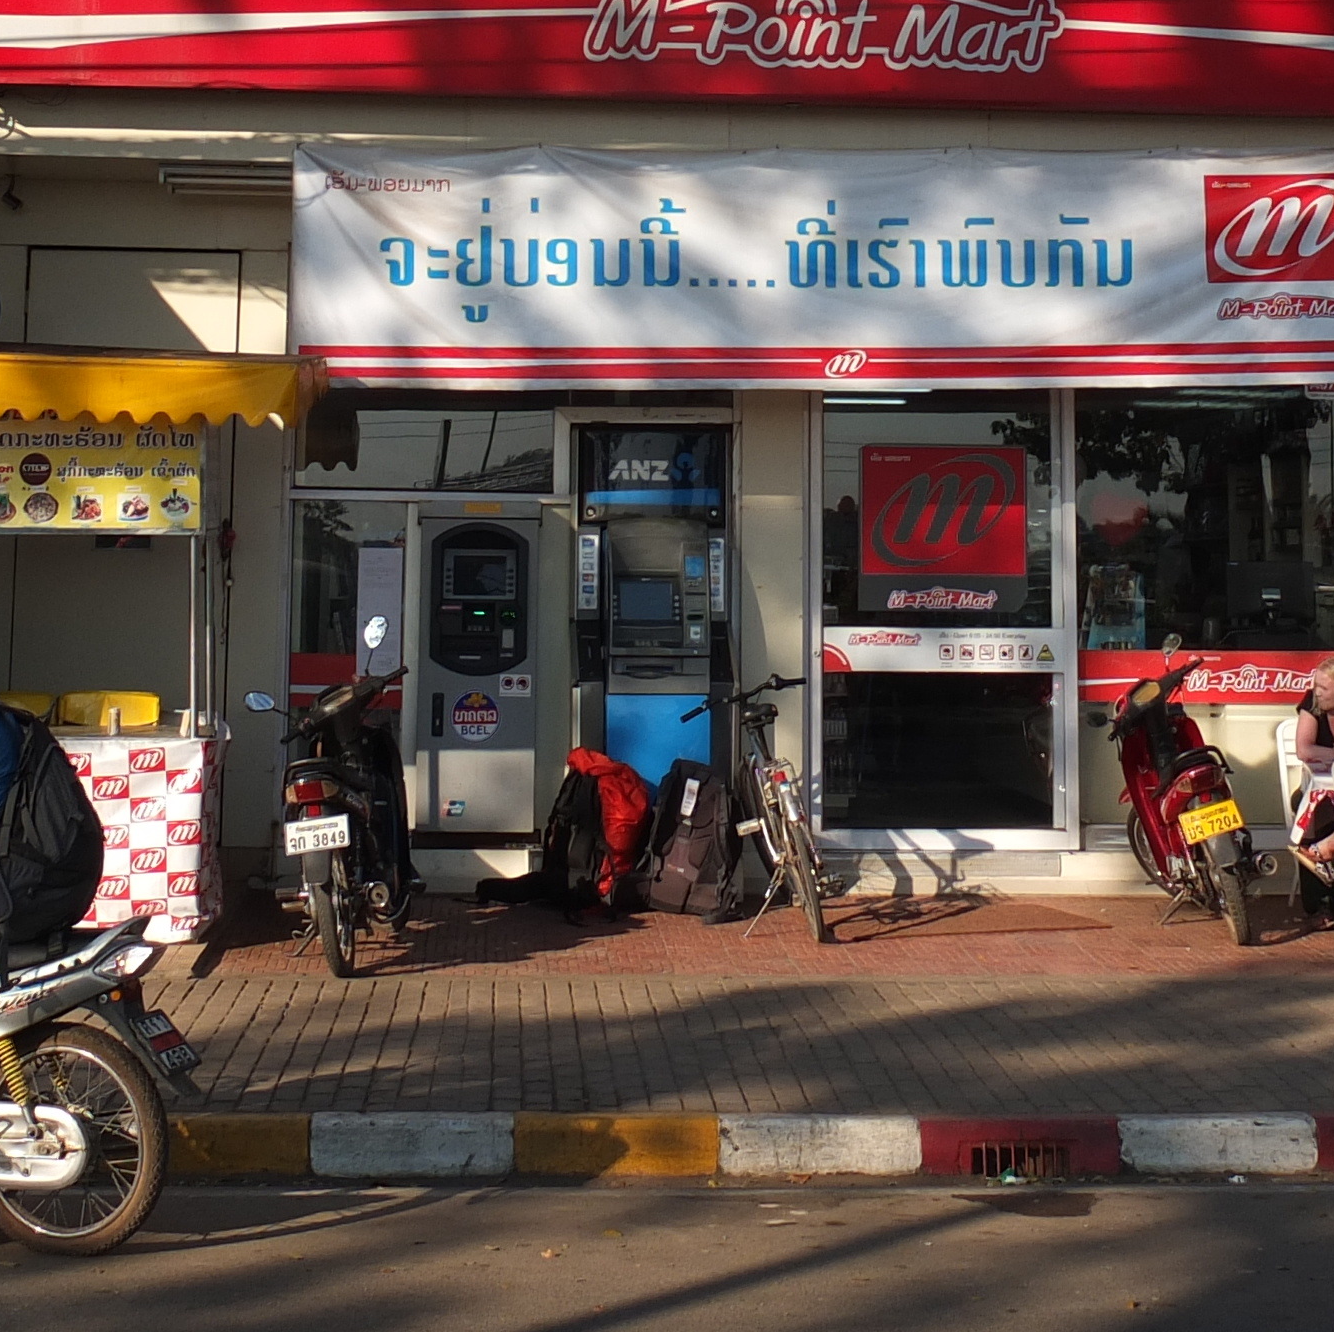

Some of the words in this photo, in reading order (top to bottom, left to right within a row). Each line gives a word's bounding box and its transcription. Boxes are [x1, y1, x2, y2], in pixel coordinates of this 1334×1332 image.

[895, 1, 1056, 62] Mart
[608, 459, 670, 481] ANZ
[958, 591, 996, 609] Mart
[461, 725, 491, 735] BCEL
[1207, 813, 1240, 833] 7204
[313, 829, 347, 848] 3849
